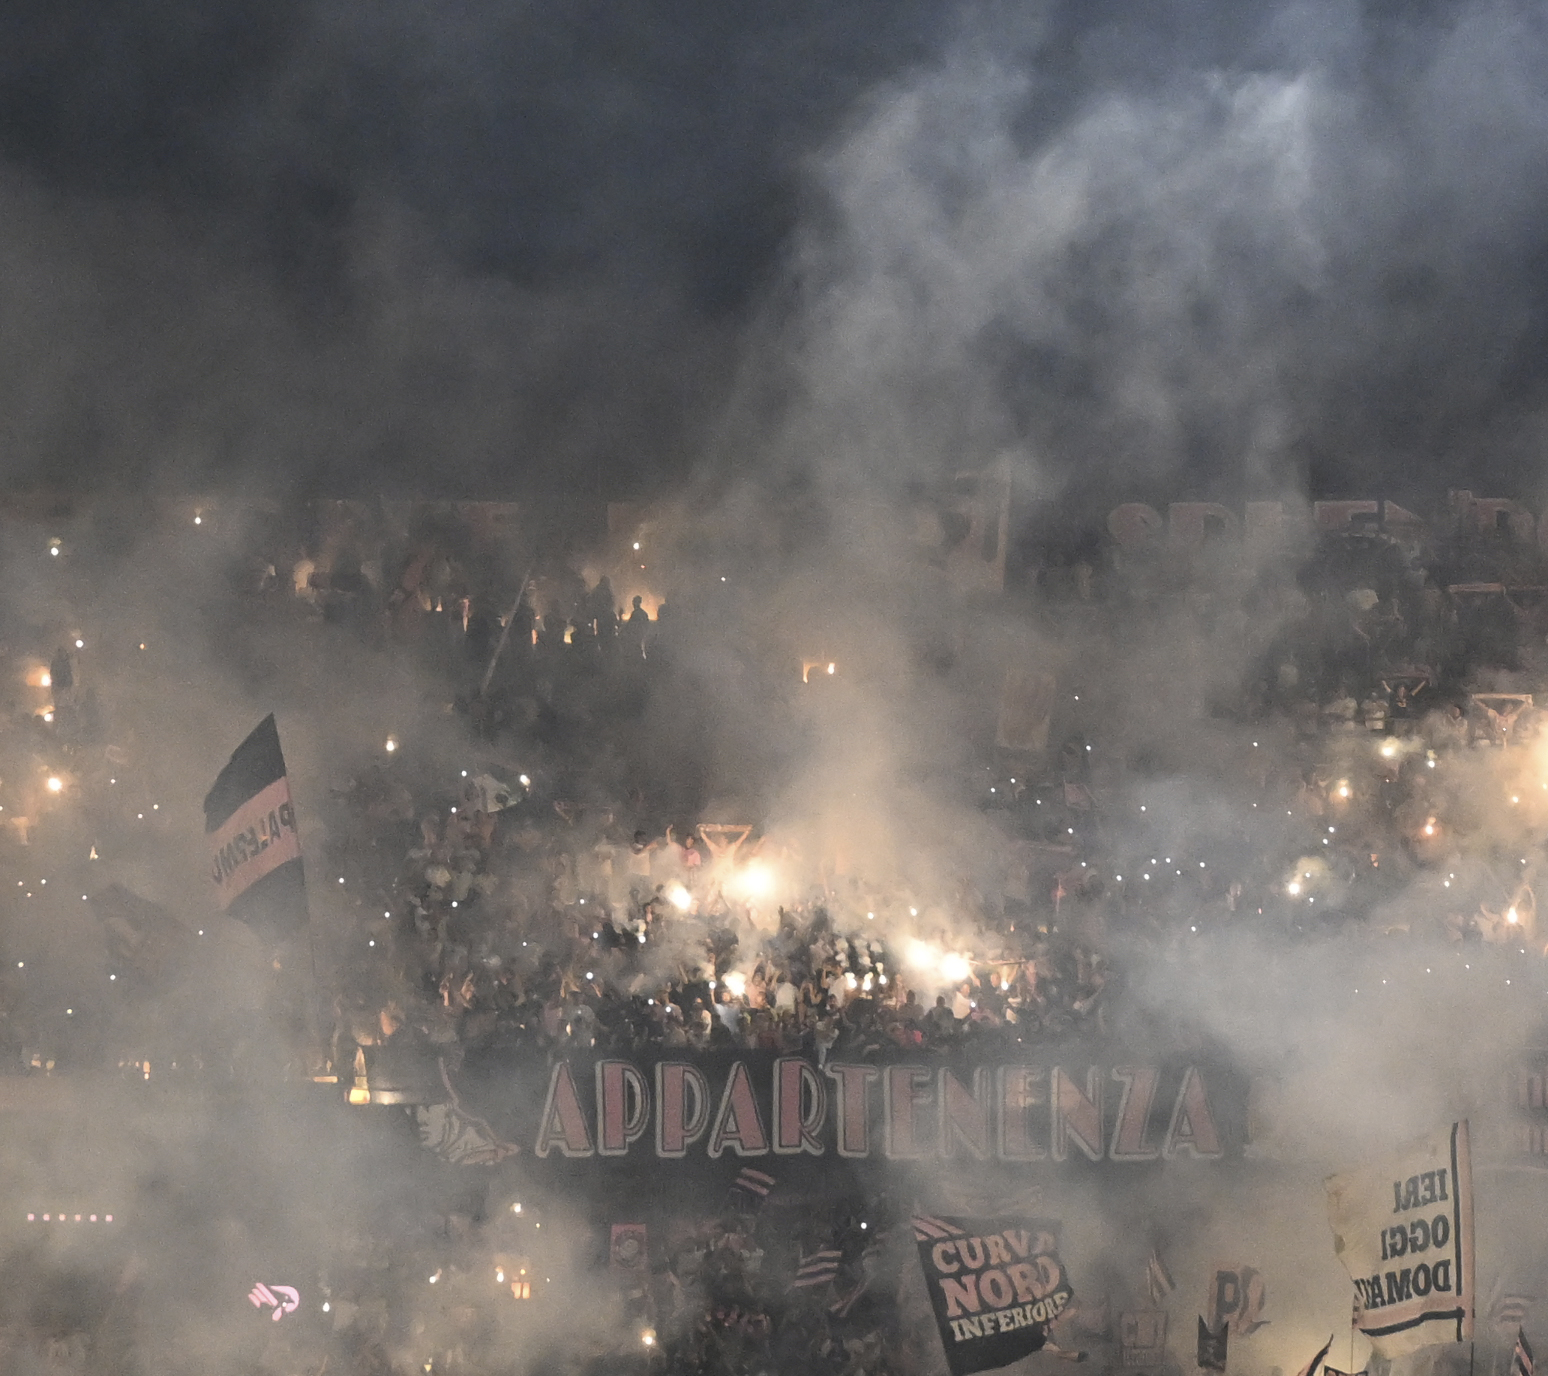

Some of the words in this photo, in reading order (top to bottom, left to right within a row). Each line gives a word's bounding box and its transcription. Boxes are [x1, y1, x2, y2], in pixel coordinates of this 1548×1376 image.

[536, 1055, 1226, 1162] APPARTENENZA
[939, 1255, 1062, 1318] NORD
[949, 1291, 1070, 1342] INFERIORE
